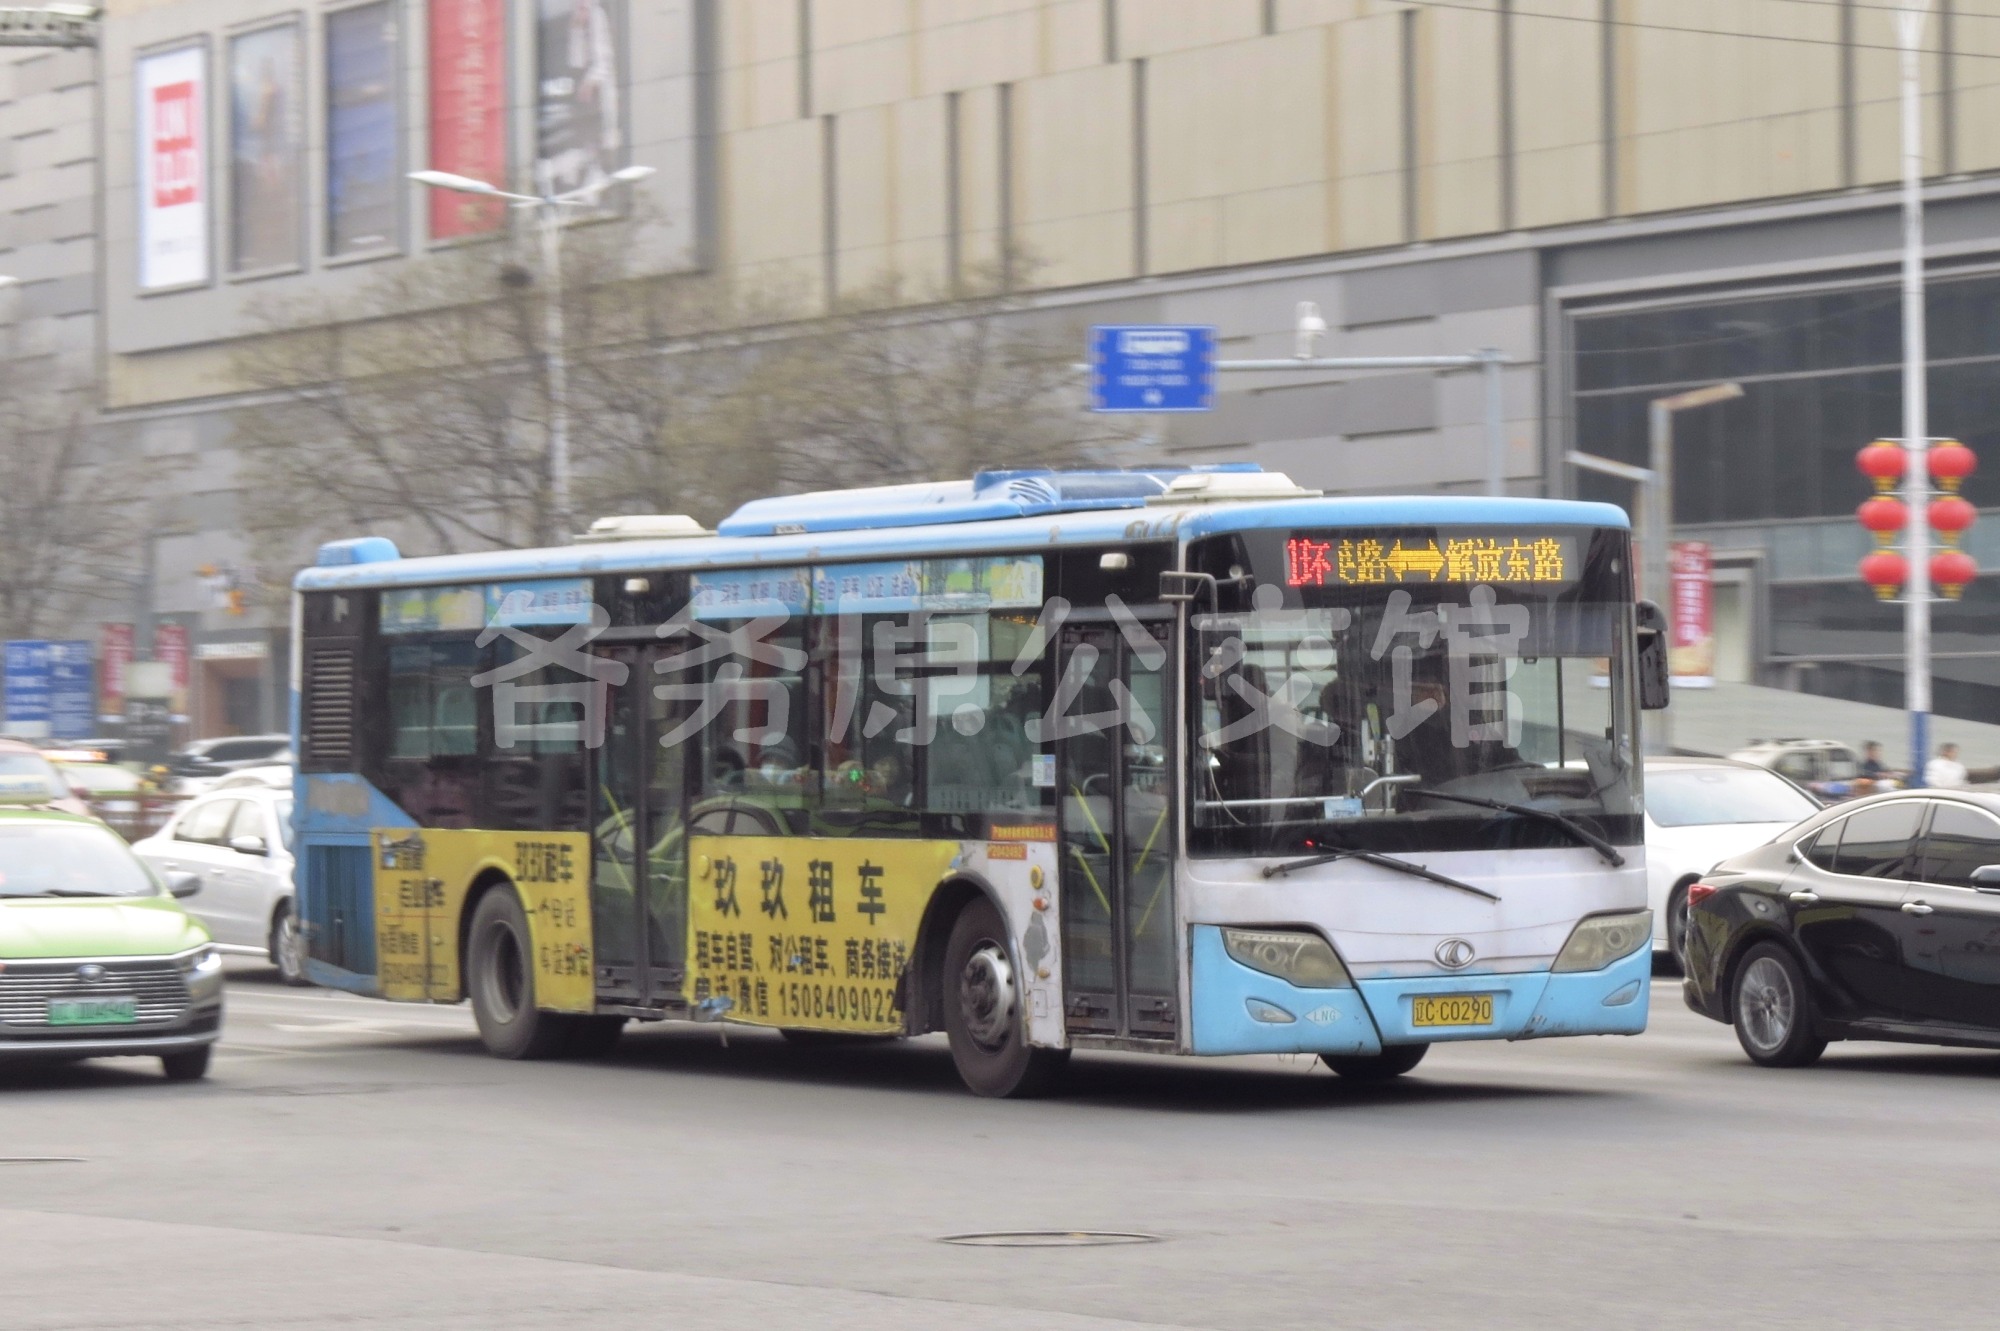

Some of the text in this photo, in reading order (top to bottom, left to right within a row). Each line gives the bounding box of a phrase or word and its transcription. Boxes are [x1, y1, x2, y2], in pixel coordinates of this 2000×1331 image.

[1444, 537, 1563, 582] 解放东路
[714, 855, 887, 926] 玖玖租车
[1313, 1010, 1338, 1023] LNG
